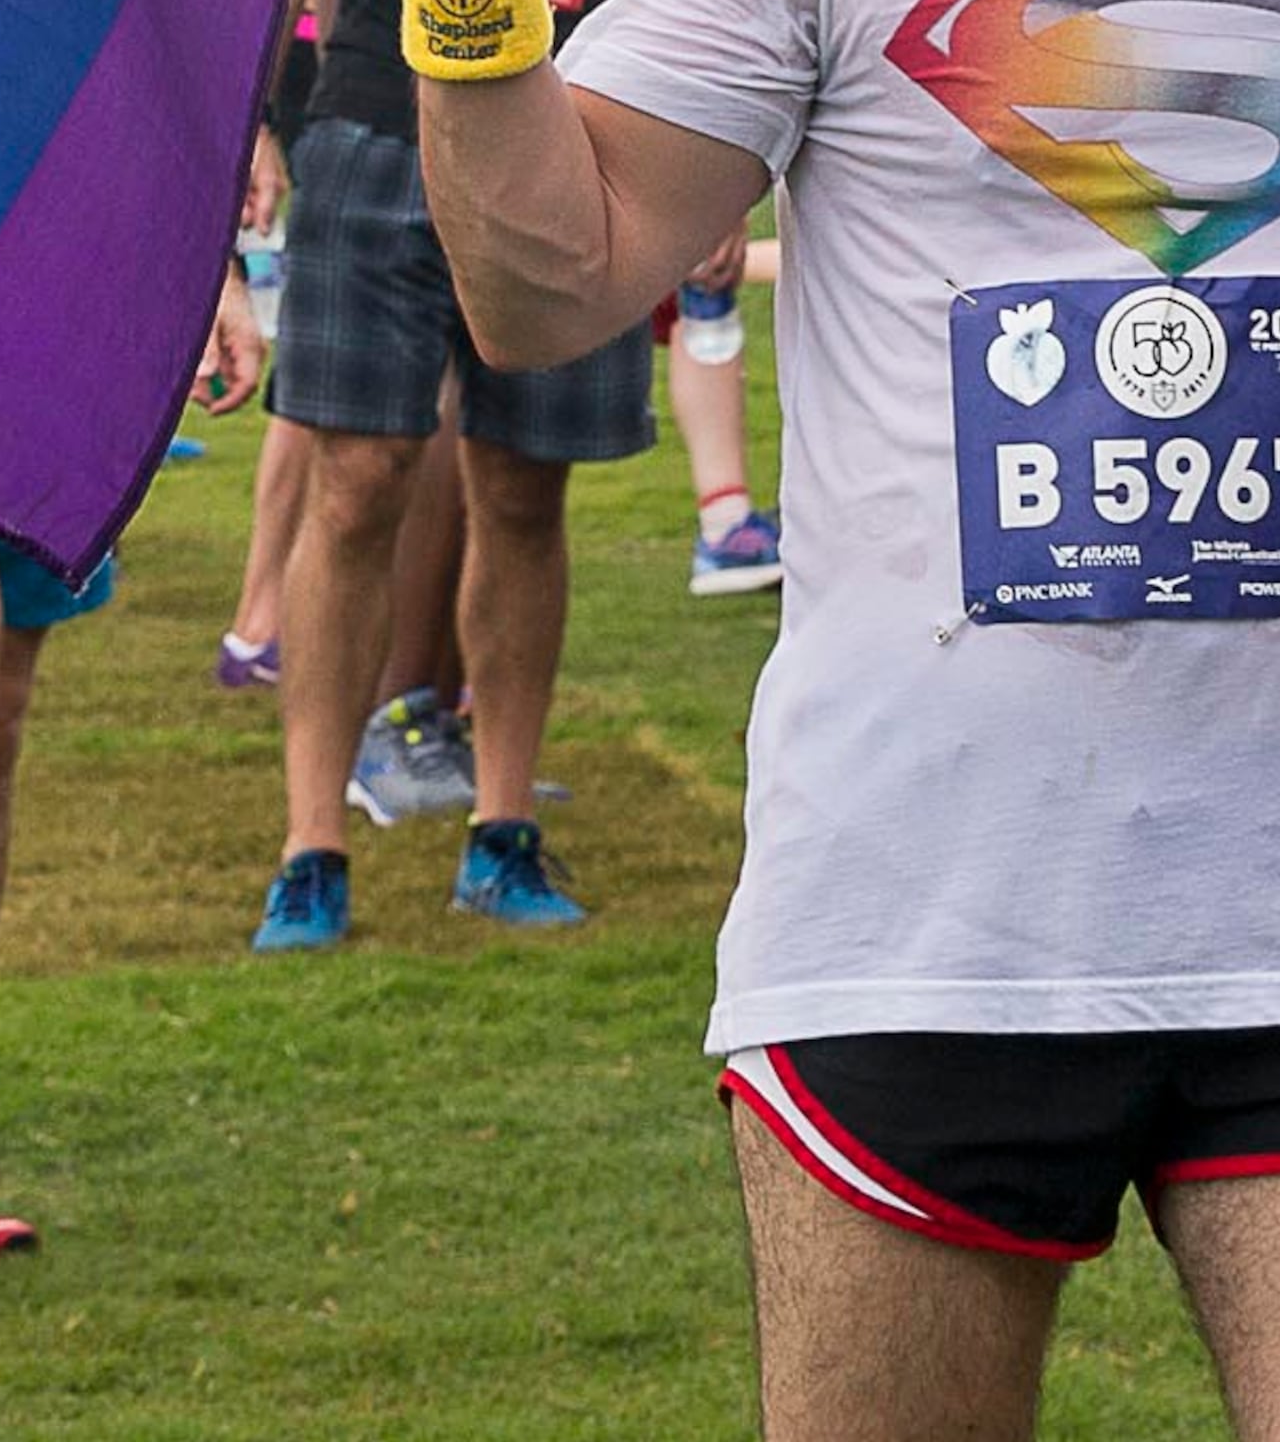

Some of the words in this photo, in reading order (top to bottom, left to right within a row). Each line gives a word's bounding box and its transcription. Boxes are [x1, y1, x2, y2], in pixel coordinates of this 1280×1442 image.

[419, 7, 513, 40] Shepherd
[428, 35, 500, 59] Center
[996, 442, 1062, 530] B
[1080, 544, 1141, 560] ATLANTA
